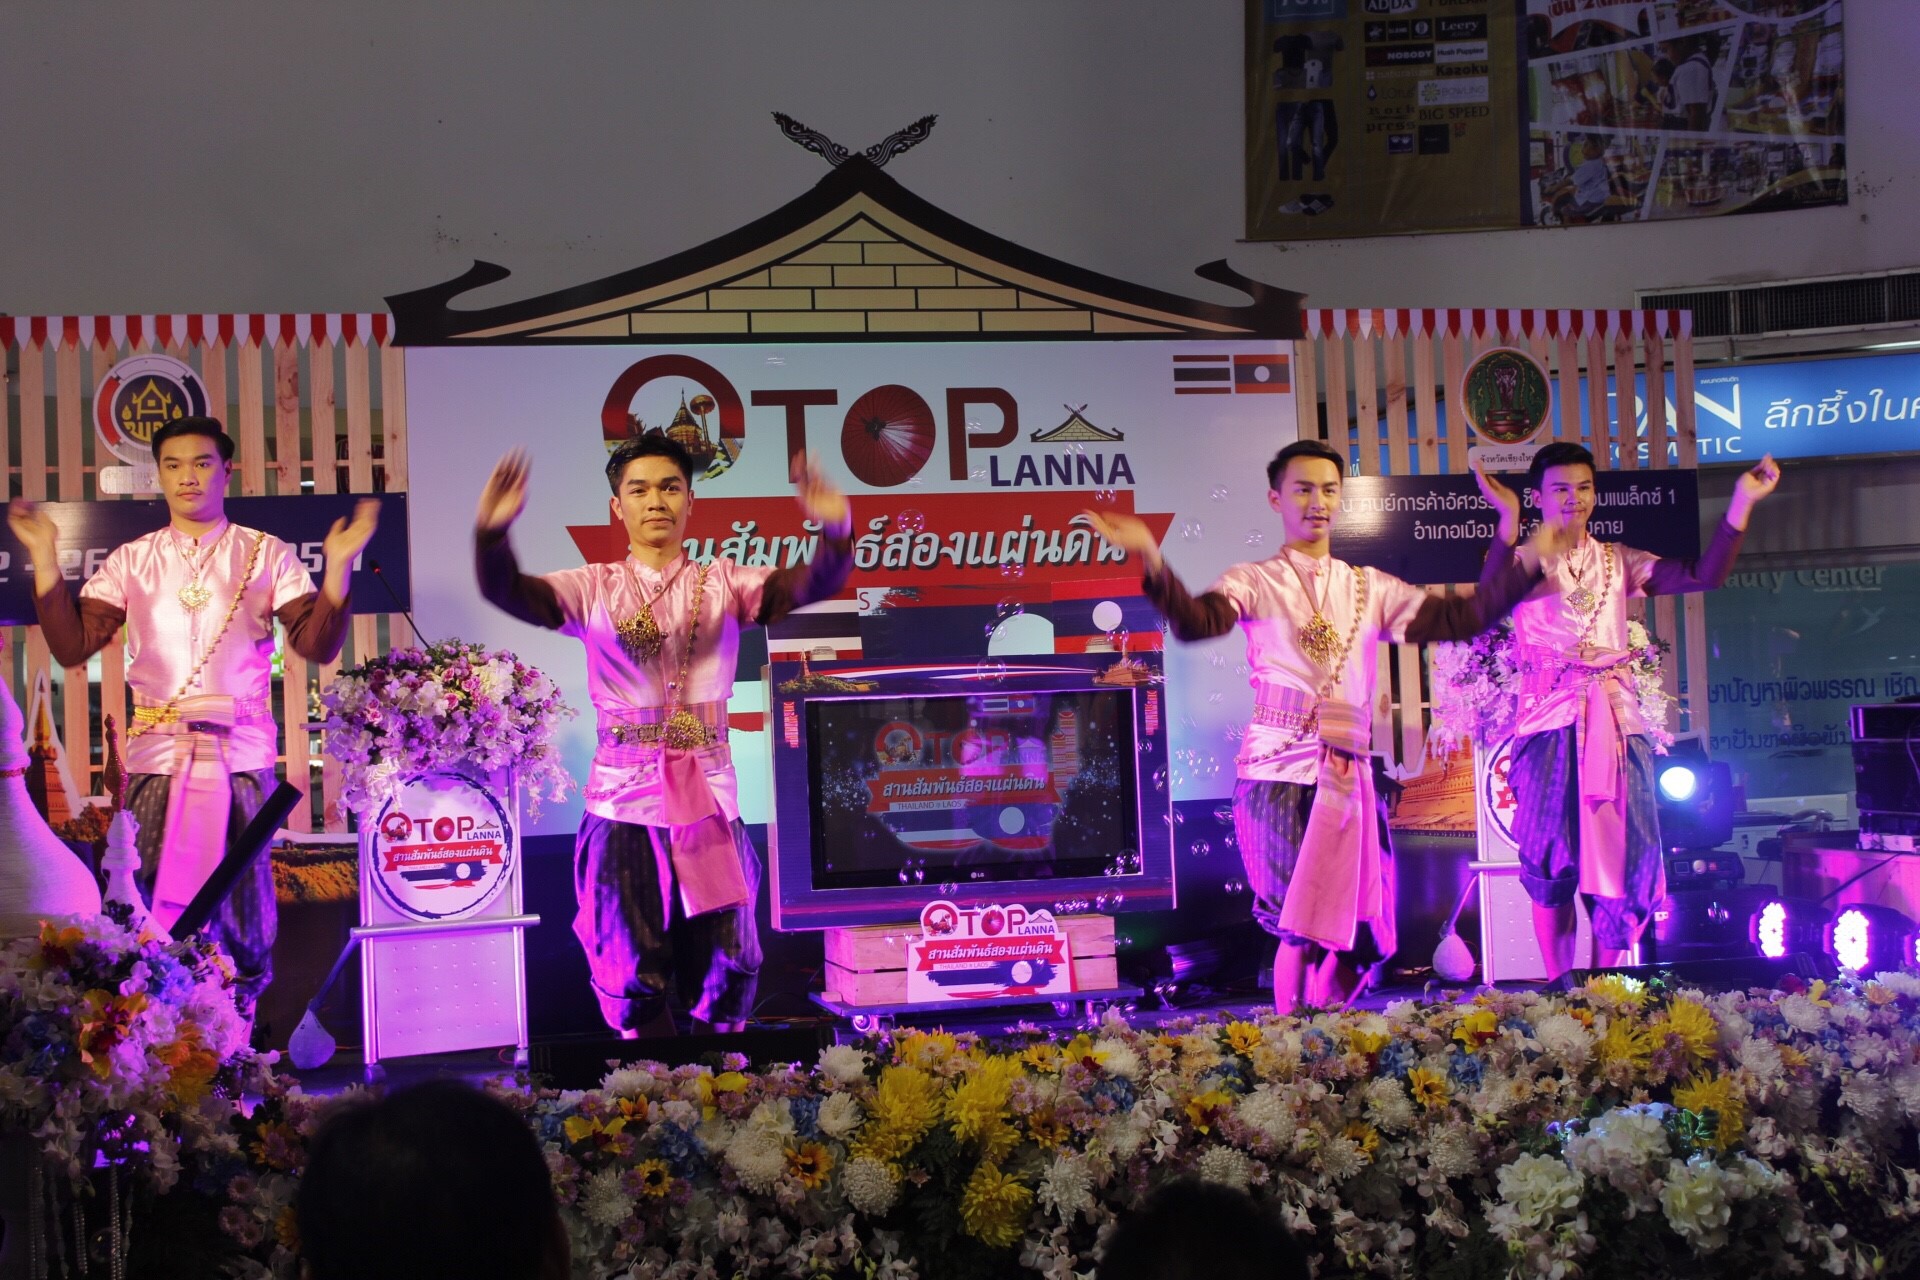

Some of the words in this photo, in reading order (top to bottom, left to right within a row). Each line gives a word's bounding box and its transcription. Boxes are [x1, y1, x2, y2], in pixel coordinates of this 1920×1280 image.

[1387, 50, 1432, 60] NOBODY
[1419, 109, 1445, 121] BIG
[1448, 106, 1490, 120] SPEED
[990, 454, 1136, 487] LANNA
[466, 830, 502, 841] LANNA
[1018, 924, 1056, 936] LANNA
